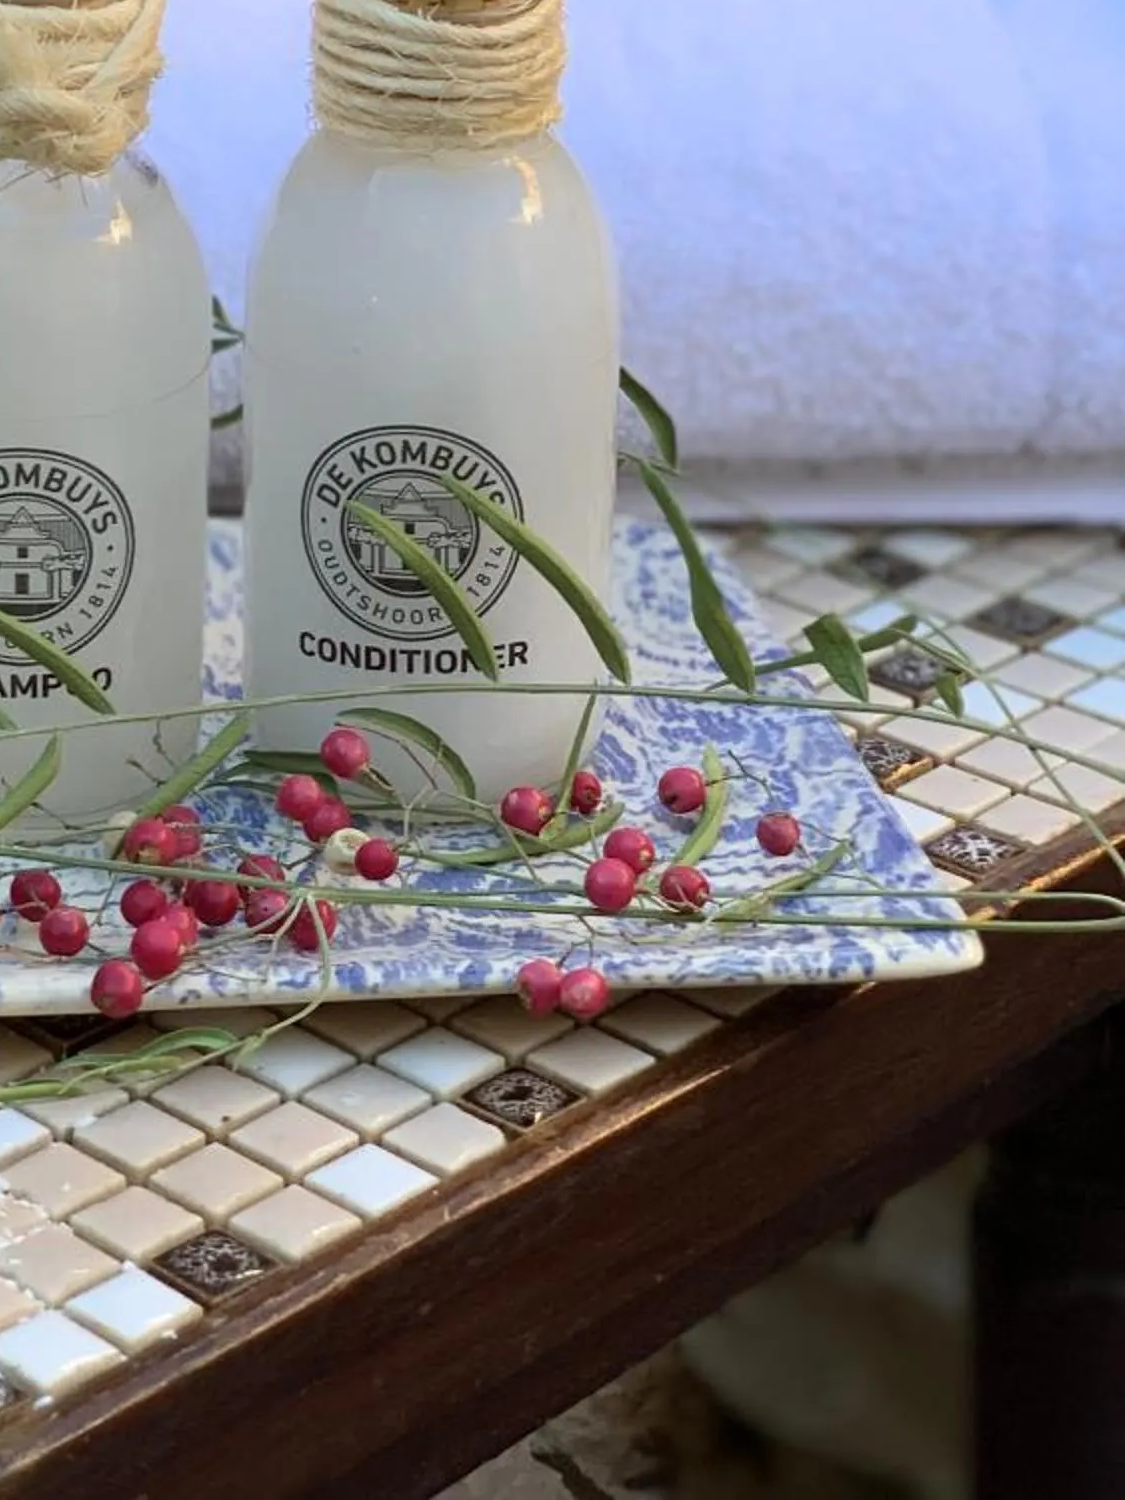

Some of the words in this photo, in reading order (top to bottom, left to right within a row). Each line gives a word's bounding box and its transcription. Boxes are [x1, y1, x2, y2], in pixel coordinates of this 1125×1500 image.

[316, 463, 353, 508] DE
[79, 565, 119, 620] 1814
[318, 538, 443, 626] OUDTSHOOR
[466, 544, 506, 597] 1814
